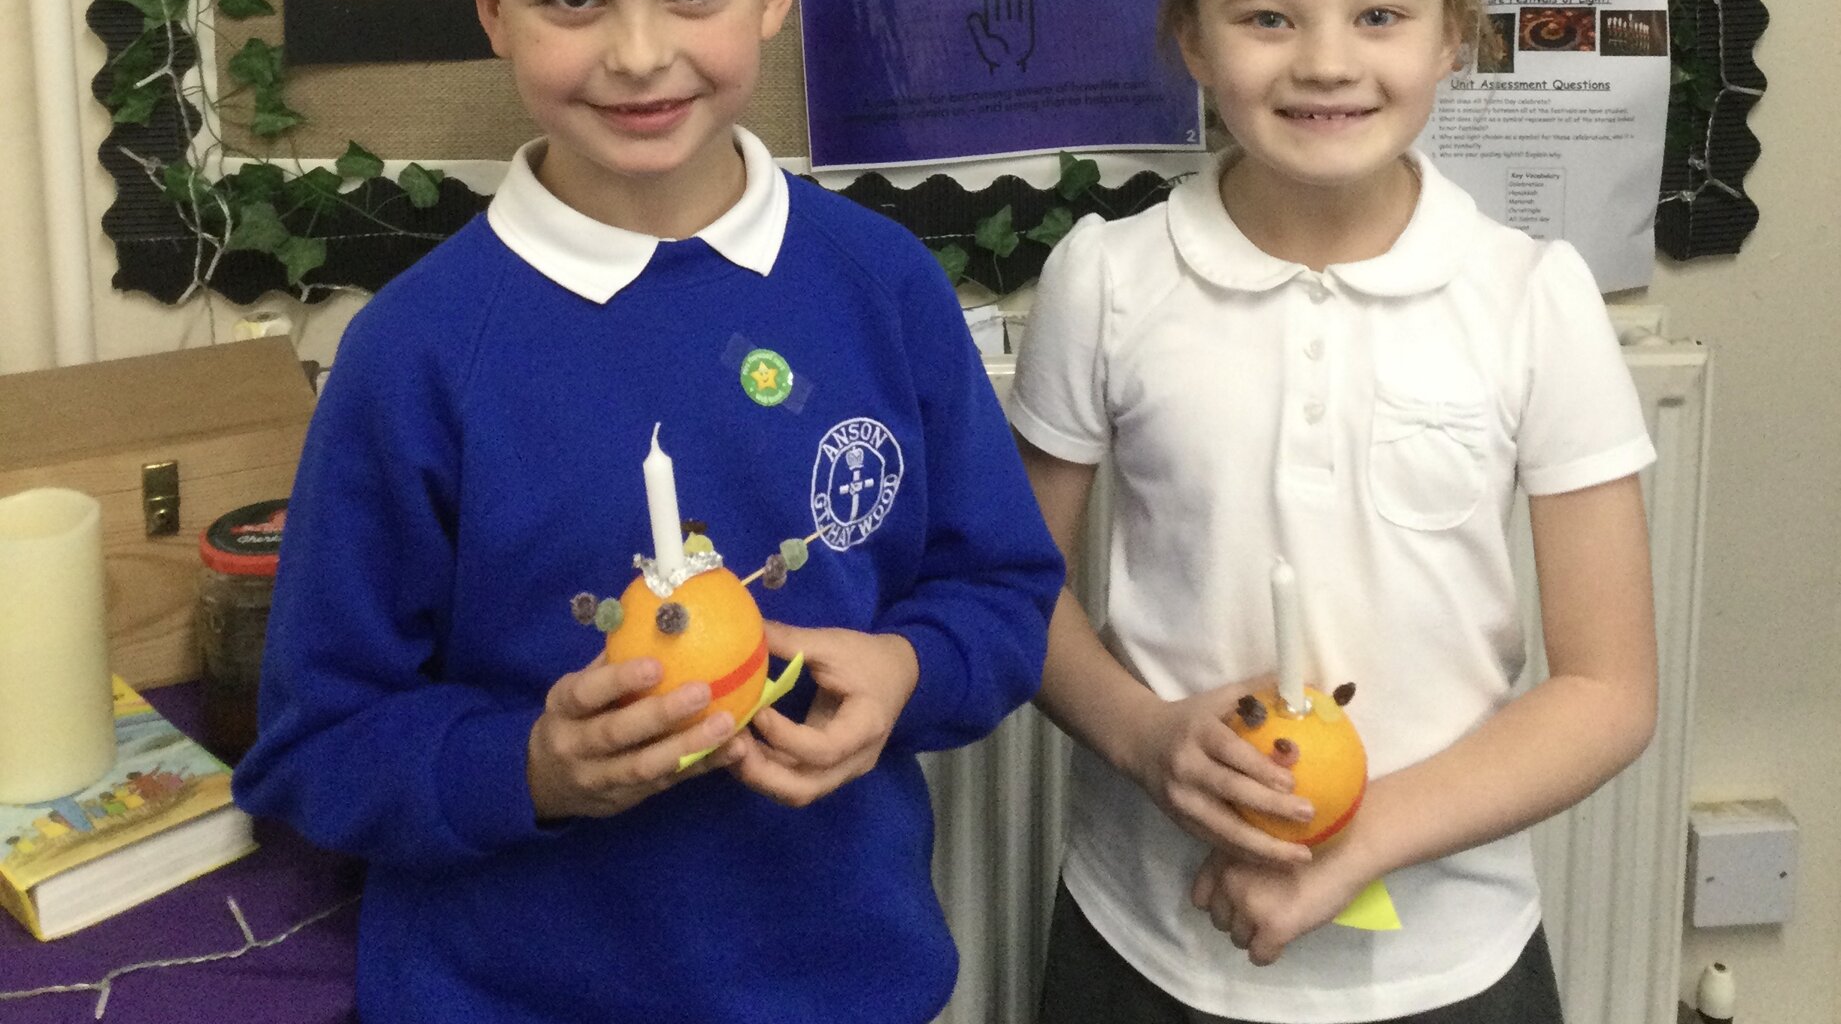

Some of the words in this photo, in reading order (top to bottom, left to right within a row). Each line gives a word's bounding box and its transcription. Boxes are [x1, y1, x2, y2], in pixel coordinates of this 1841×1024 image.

[1450, 80, 1474, 89] Unit
[1481, 80, 1547, 90] Assessment
[1553, 80, 1611, 90] Questions
[1186, 130, 1196, 142] 2
[823, 423, 888, 462] ANSON
